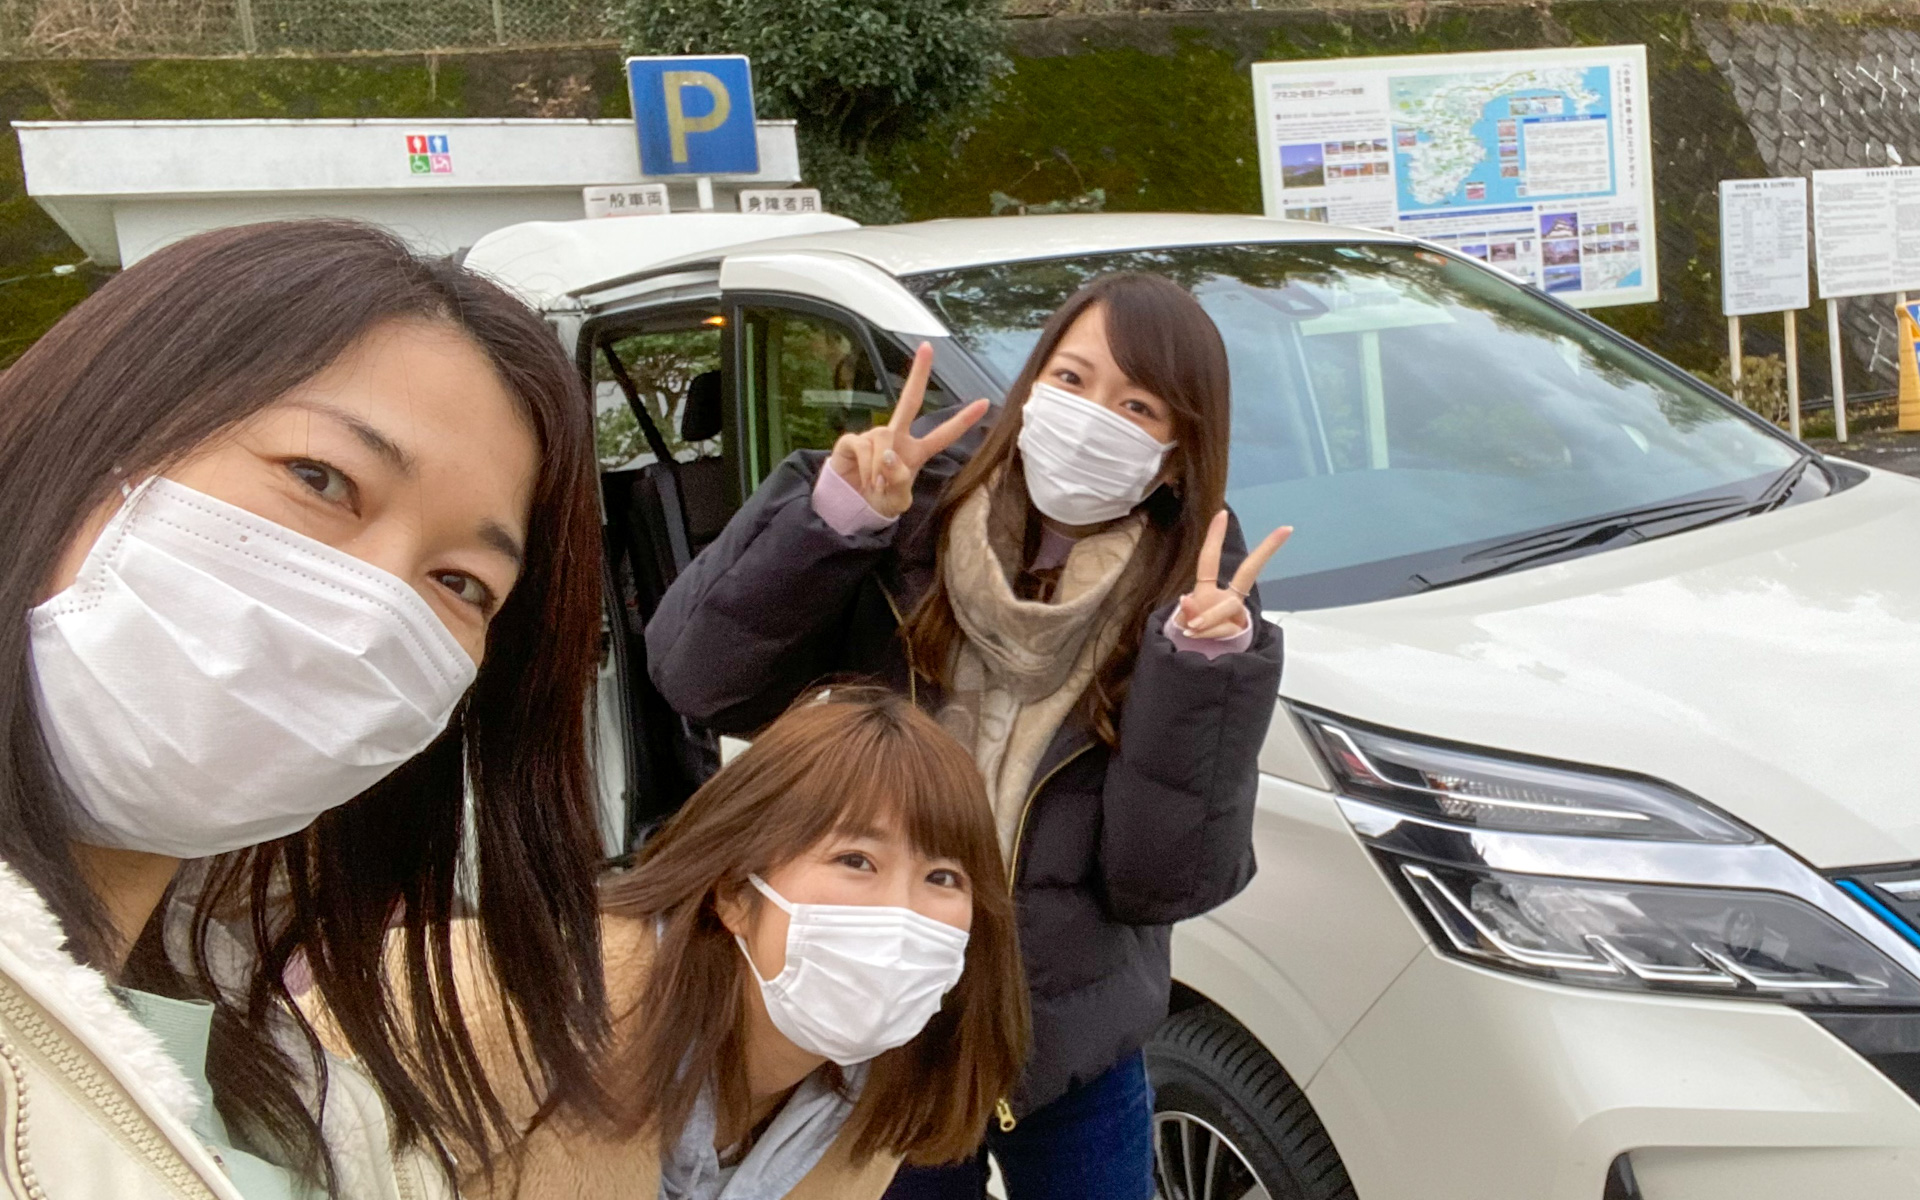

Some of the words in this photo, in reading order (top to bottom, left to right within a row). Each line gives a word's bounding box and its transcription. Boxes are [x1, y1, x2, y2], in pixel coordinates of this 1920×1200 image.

[662, 70, 731, 163] P
[589, 191, 662, 208] 一般車両
[748, 196, 815, 212] 身障者用
